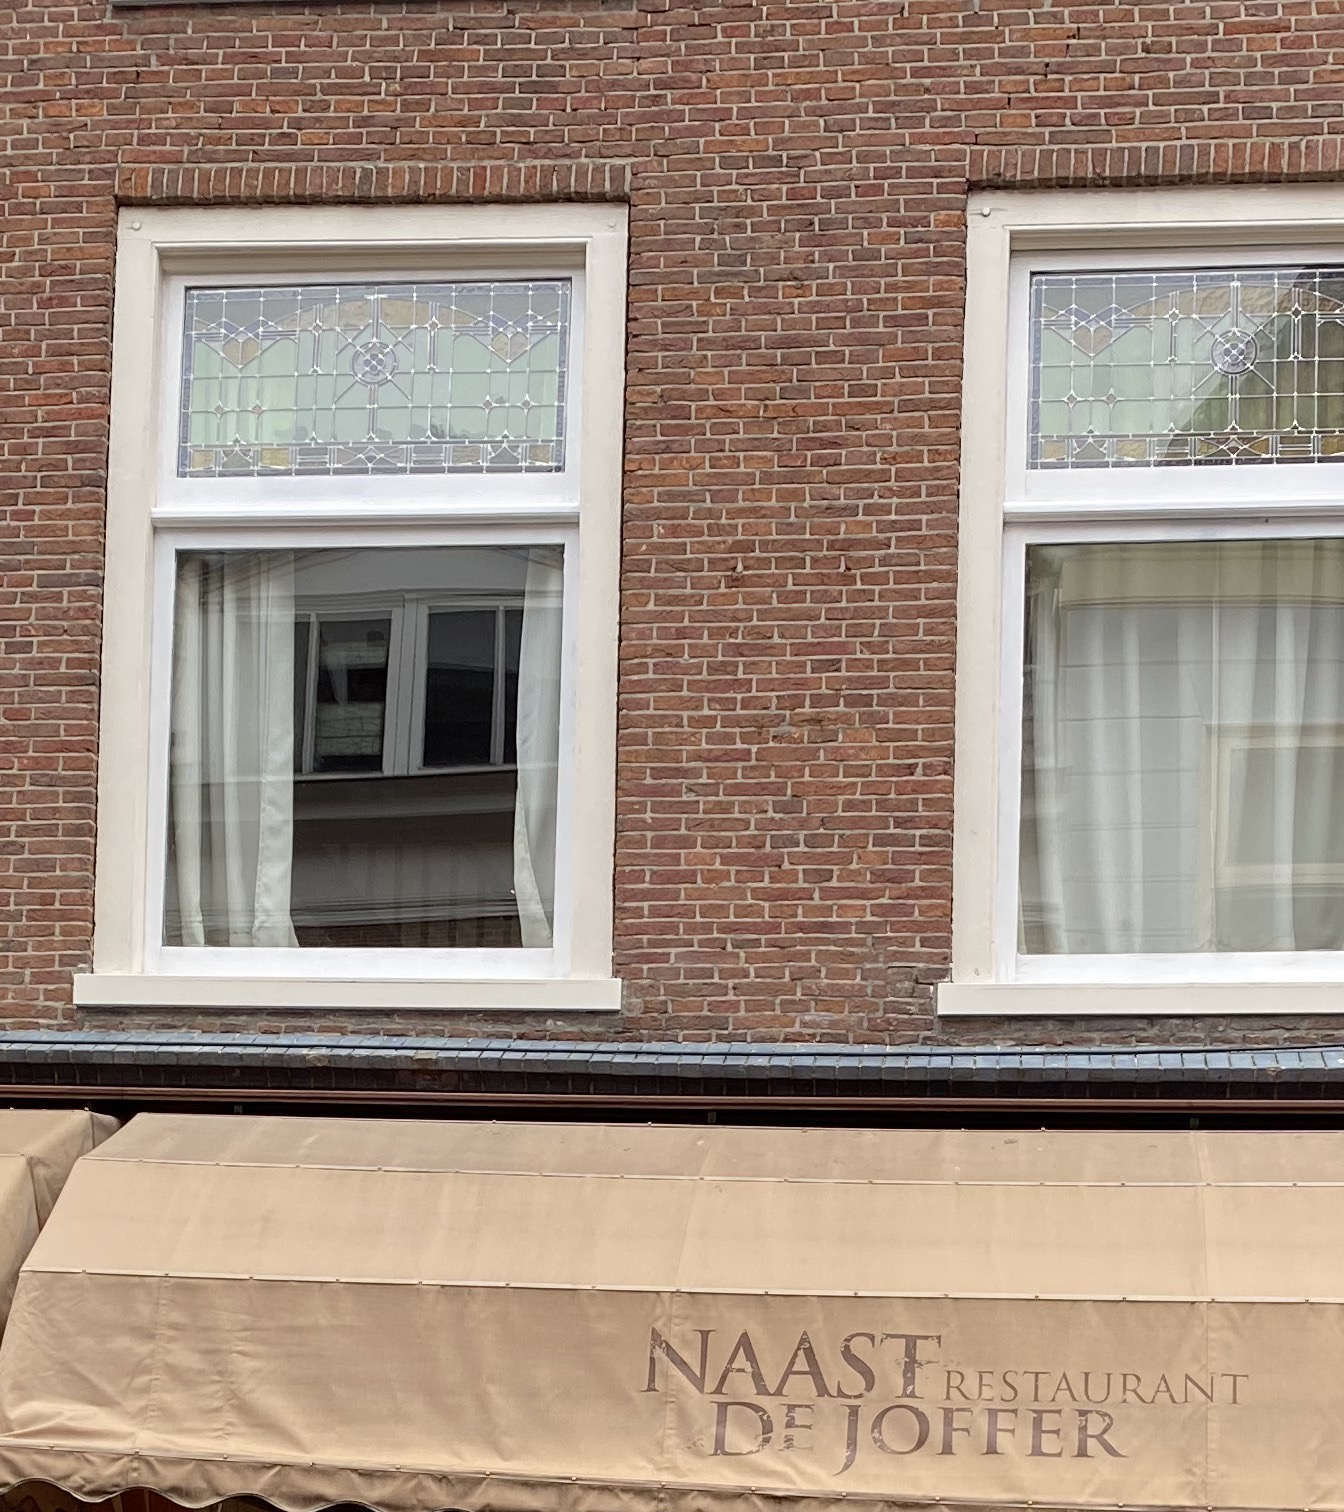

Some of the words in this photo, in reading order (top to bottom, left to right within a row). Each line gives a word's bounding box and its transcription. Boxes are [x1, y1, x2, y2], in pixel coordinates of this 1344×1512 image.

[640, 1326, 942, 1400] NAAST
[943, 1369, 1250, 1405] RESTAURANT
[833, 1403, 1129, 1476] JOFFER
